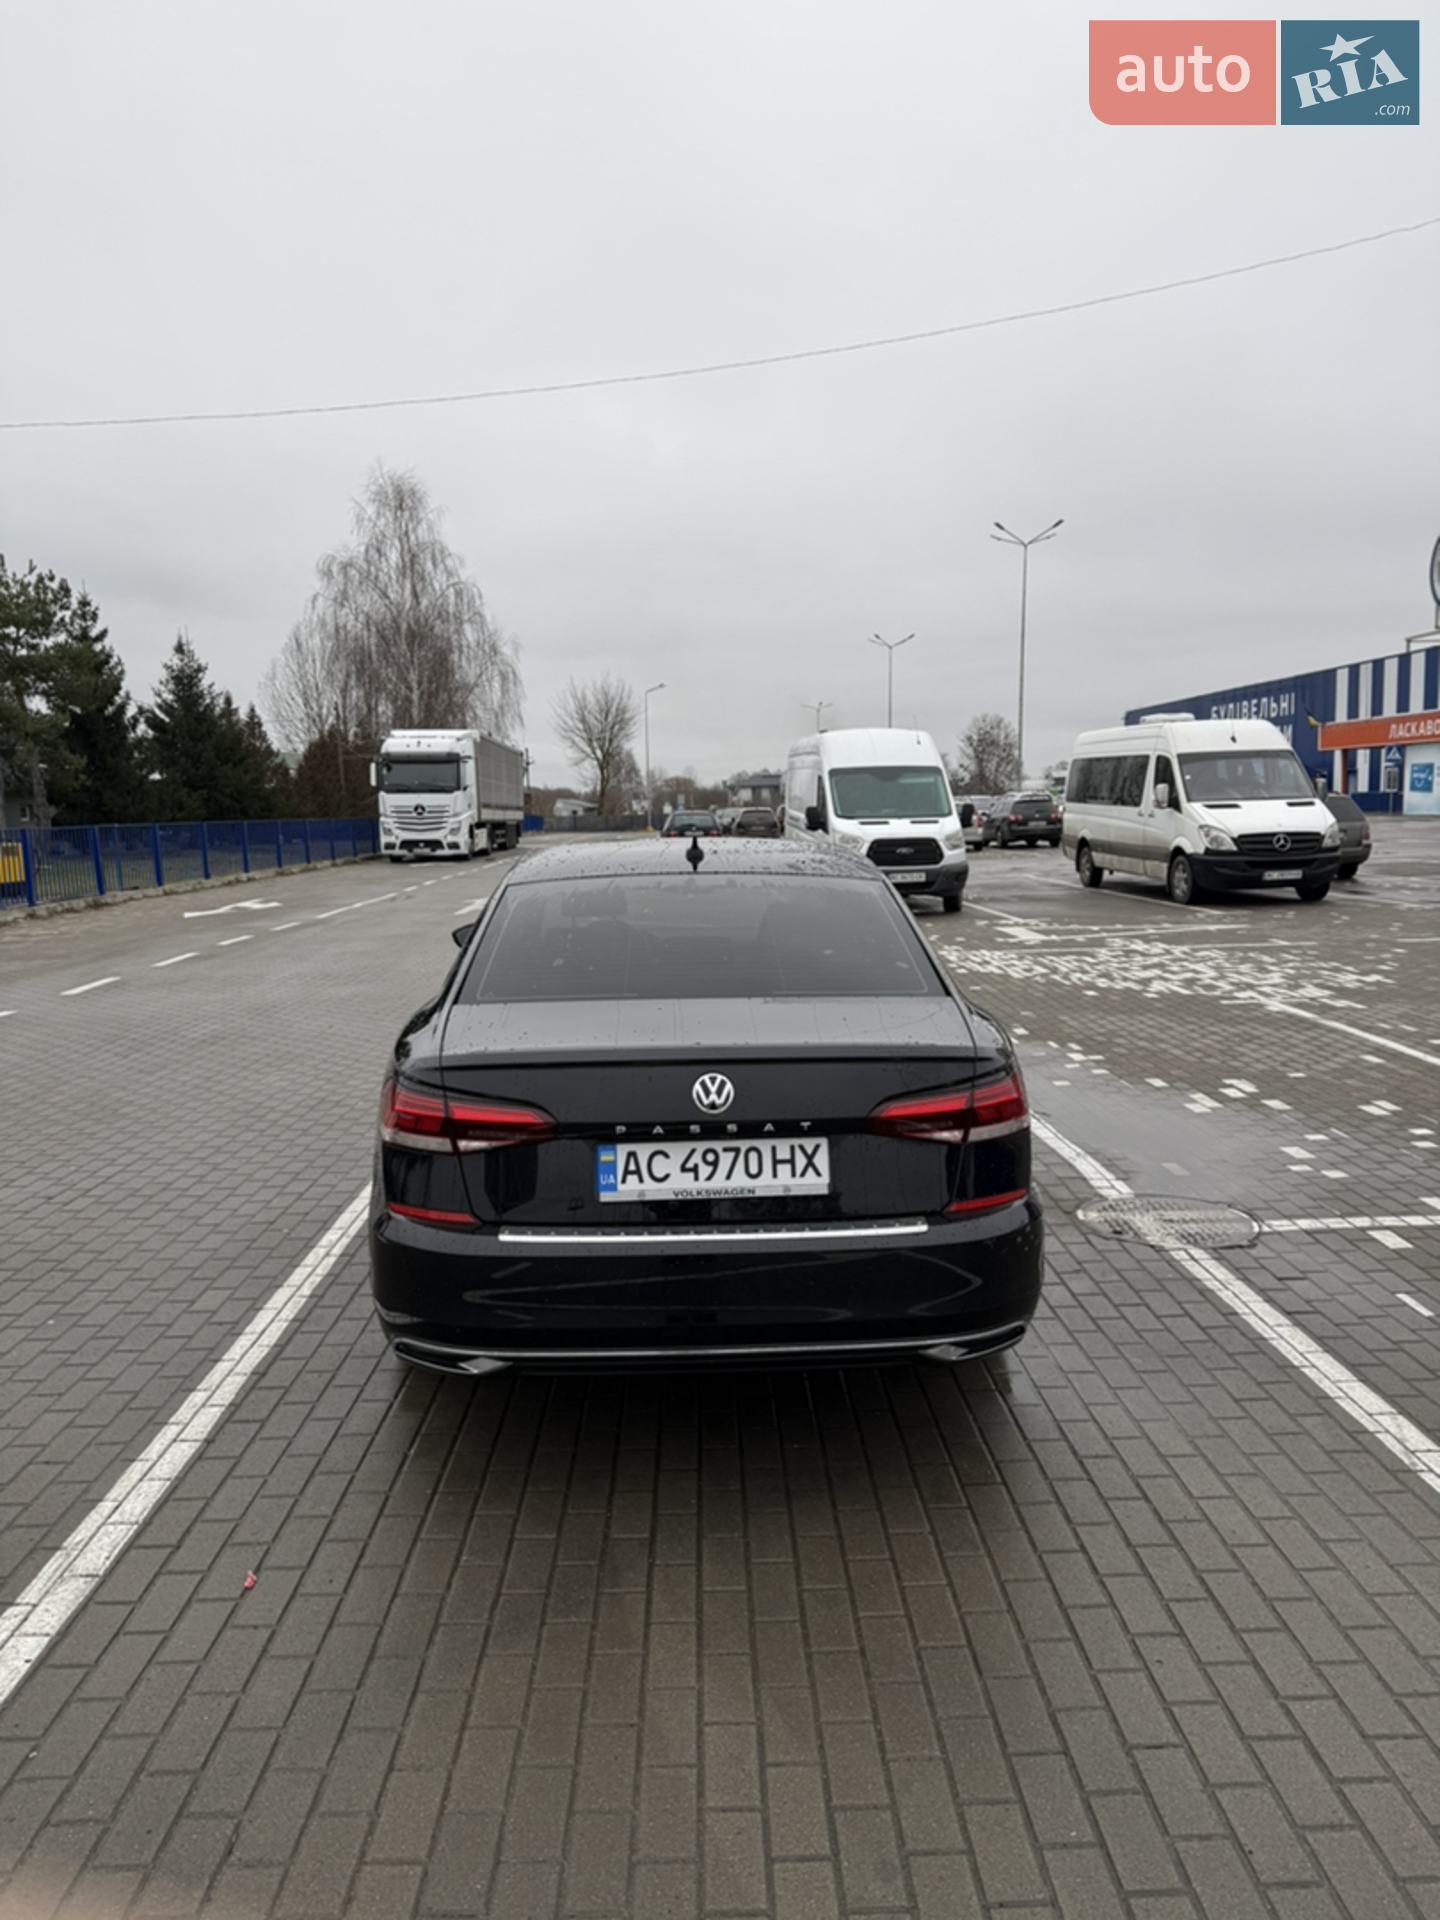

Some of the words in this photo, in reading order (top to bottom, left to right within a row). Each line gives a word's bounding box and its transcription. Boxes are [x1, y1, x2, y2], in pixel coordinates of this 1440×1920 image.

[615, 1121, 812, 1135] PASSAT
[679, 1146, 764, 1182] 4970
[600, 1173, 616, 1185] UA
[673, 1186, 757, 1199] VOLKSWAGEN
